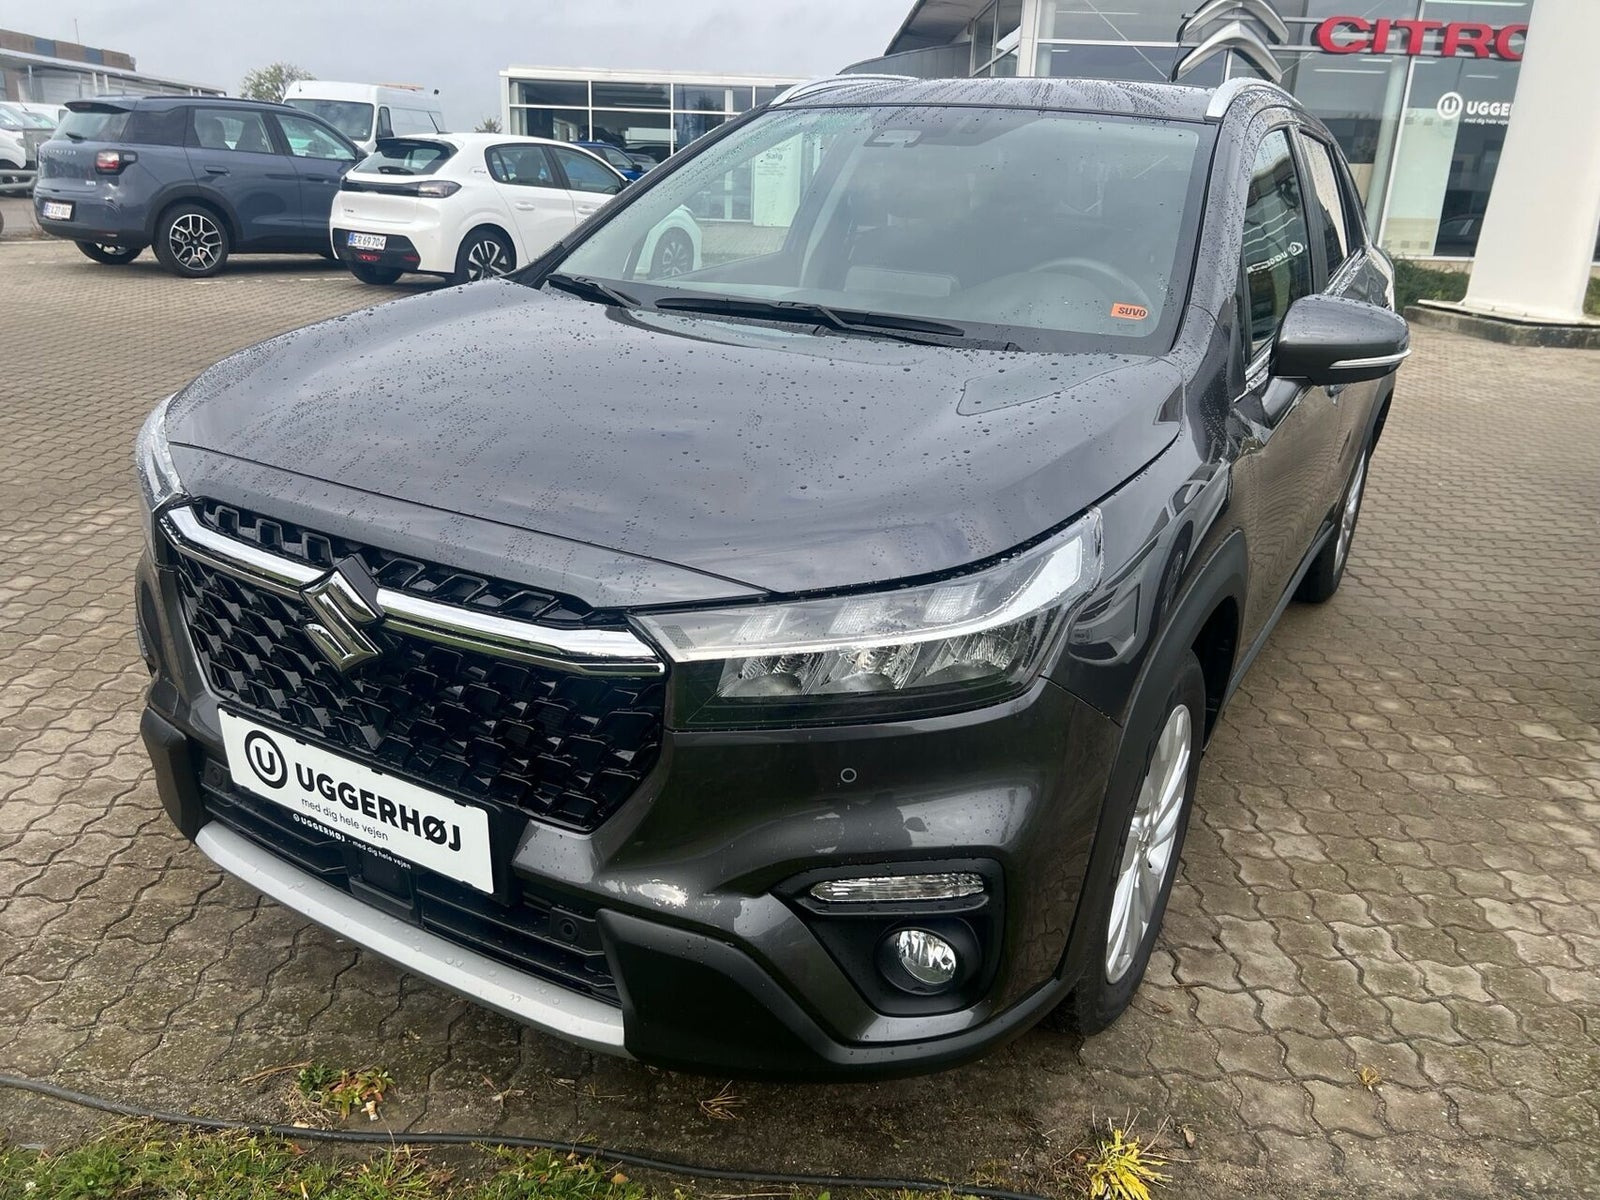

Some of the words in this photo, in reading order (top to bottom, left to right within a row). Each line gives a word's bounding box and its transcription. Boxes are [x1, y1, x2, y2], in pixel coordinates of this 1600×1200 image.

[1118, 306, 1147, 317] SUVO
[295, 762, 462, 852] UGGERHØJ
[301, 797, 321, 813] med
[322, 806, 338, 822] dig
[339, 812, 360, 829] hele
[361, 823, 389, 841] vejen
[300, 816, 345, 842] UGGERHØJ
[352, 840, 366, 850] med
[367, 846, 378, 857] dig
[378, 850, 392, 861] hele
[393, 857, 411, 870] vejen
